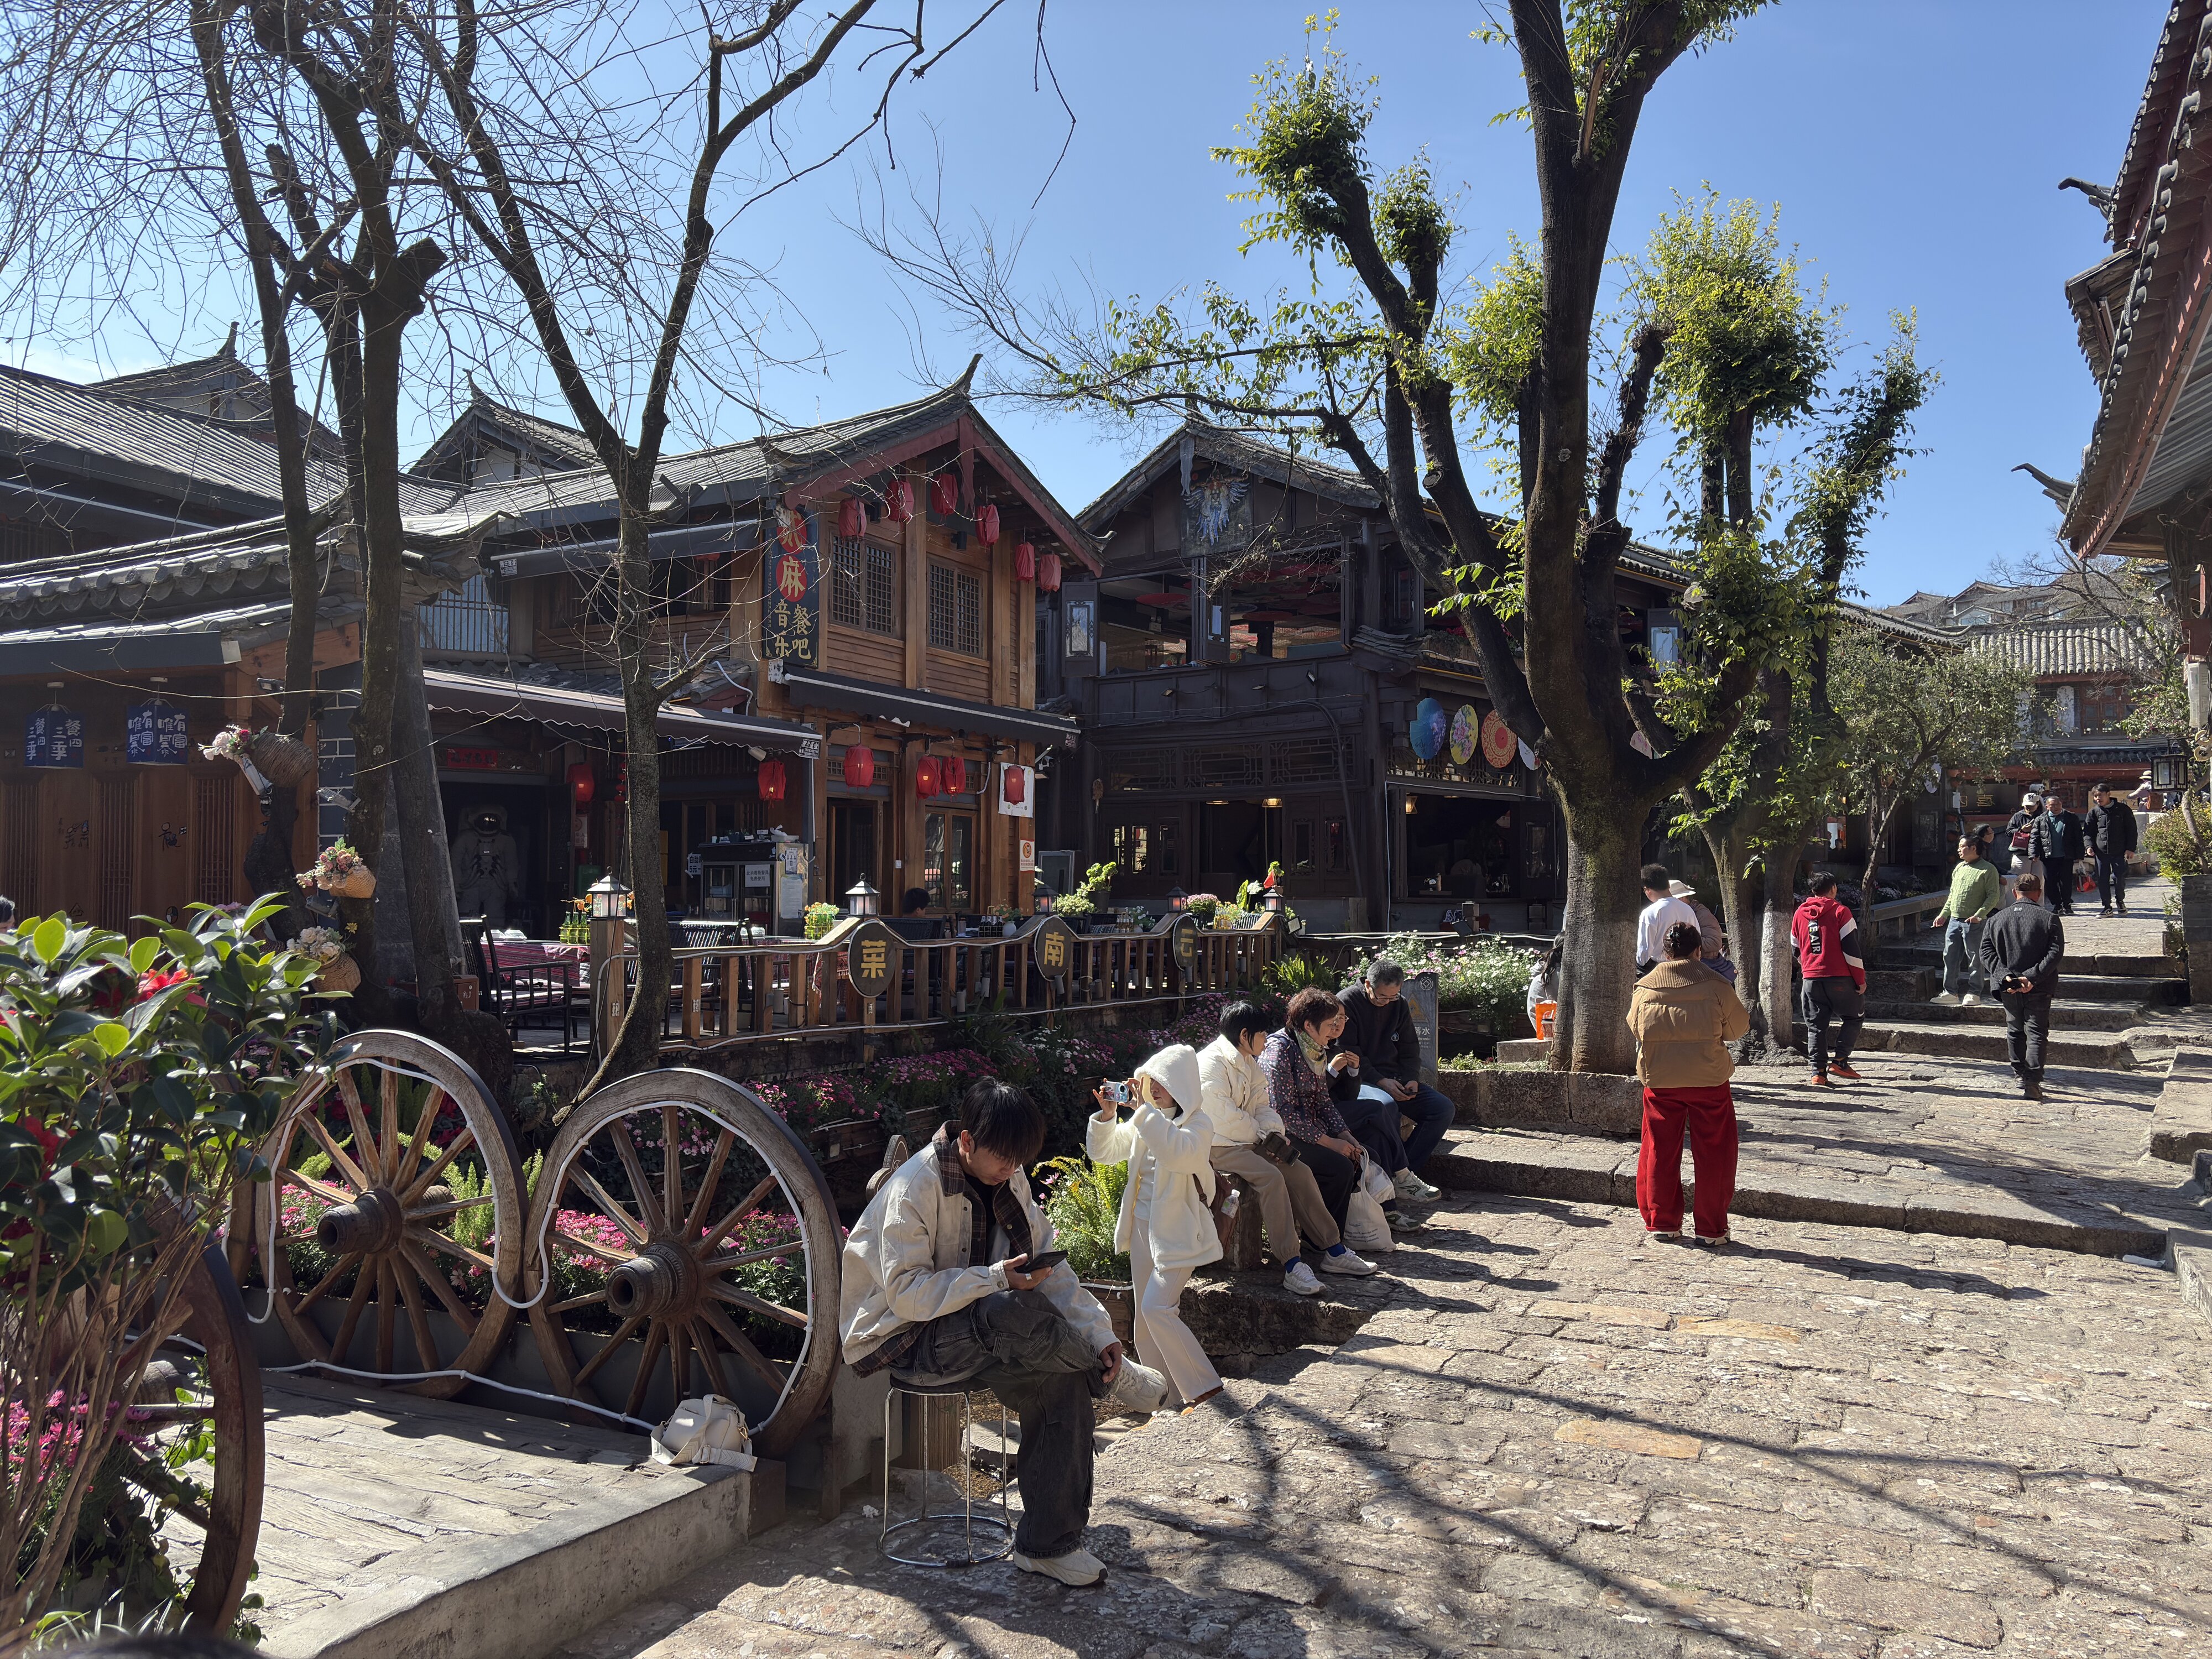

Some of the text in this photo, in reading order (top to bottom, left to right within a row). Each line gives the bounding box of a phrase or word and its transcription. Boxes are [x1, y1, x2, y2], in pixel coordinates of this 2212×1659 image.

[774, 598, 791, 658] 音乐
[792, 603, 812, 660] 餐吧
[860, 940, 886, 978] 菜
[1044, 931, 1065, 967] 南
[1180, 928, 1193, 957] 云
[1809, 934, 1821, 953] AIR
